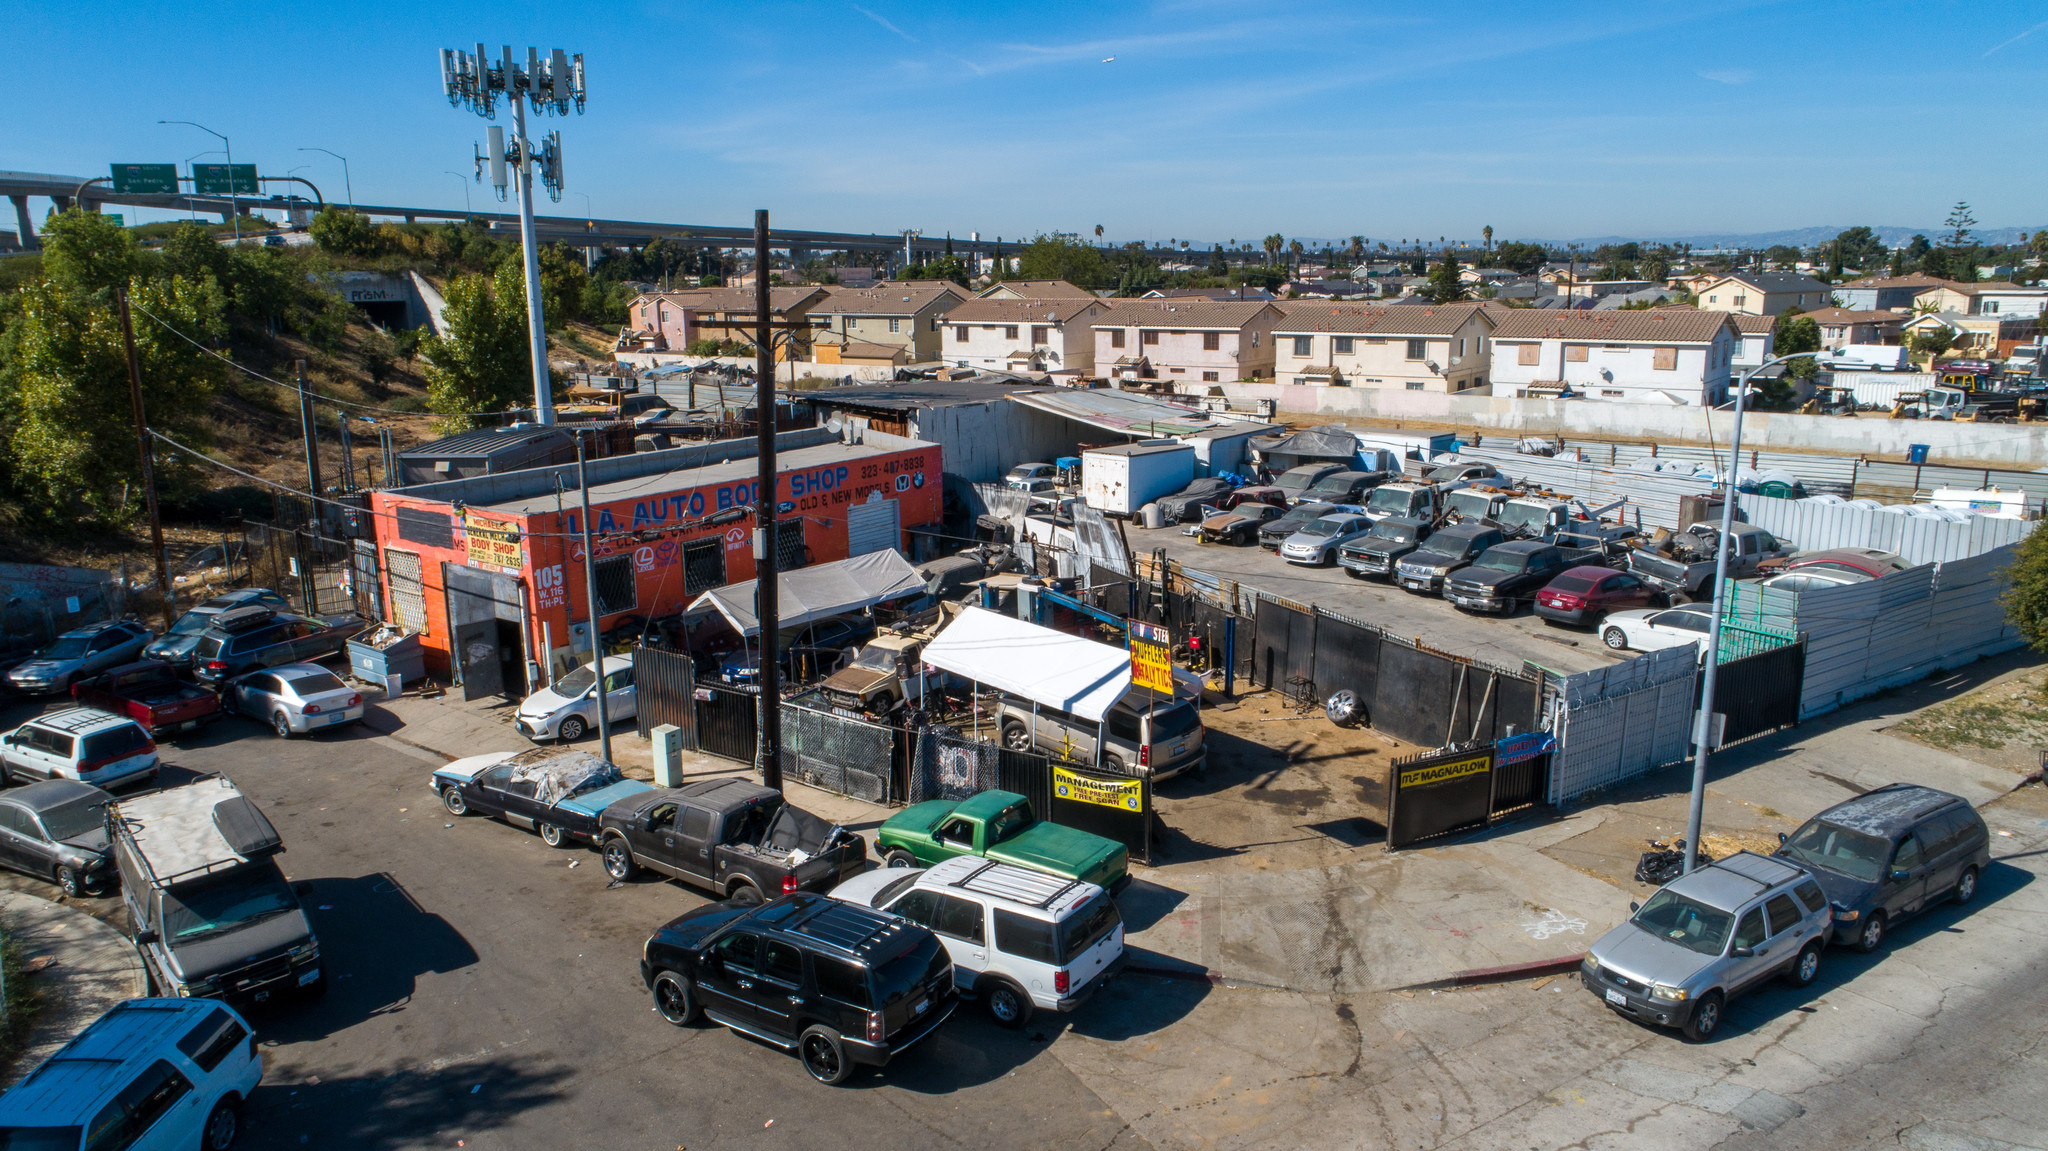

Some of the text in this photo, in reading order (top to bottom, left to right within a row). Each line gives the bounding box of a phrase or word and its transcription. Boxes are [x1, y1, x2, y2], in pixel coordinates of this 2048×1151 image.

[632, 491, 706, 530] AUTO
[716, 478, 780, 512] BOD
[790, 465, 849, 498] SHOP
[800, 482, 890, 511] OLD & NEW MODELS
[471, 537, 491, 551] BODY
[493, 541, 516, 556] SHOP
[637, 564, 655, 573] LEXUS
[657, 559, 678, 568] TOYOTA
[534, 564, 563, 589] 105
[550, 586, 564, 597] 116
[1421, 759, 1488, 782] MAGNAFLOW
[1056, 774, 1139, 796] MANAGEMENT
[1089, 790, 1119, 799] PRE-TEST
[1074, 793, 1095, 803] FREE
